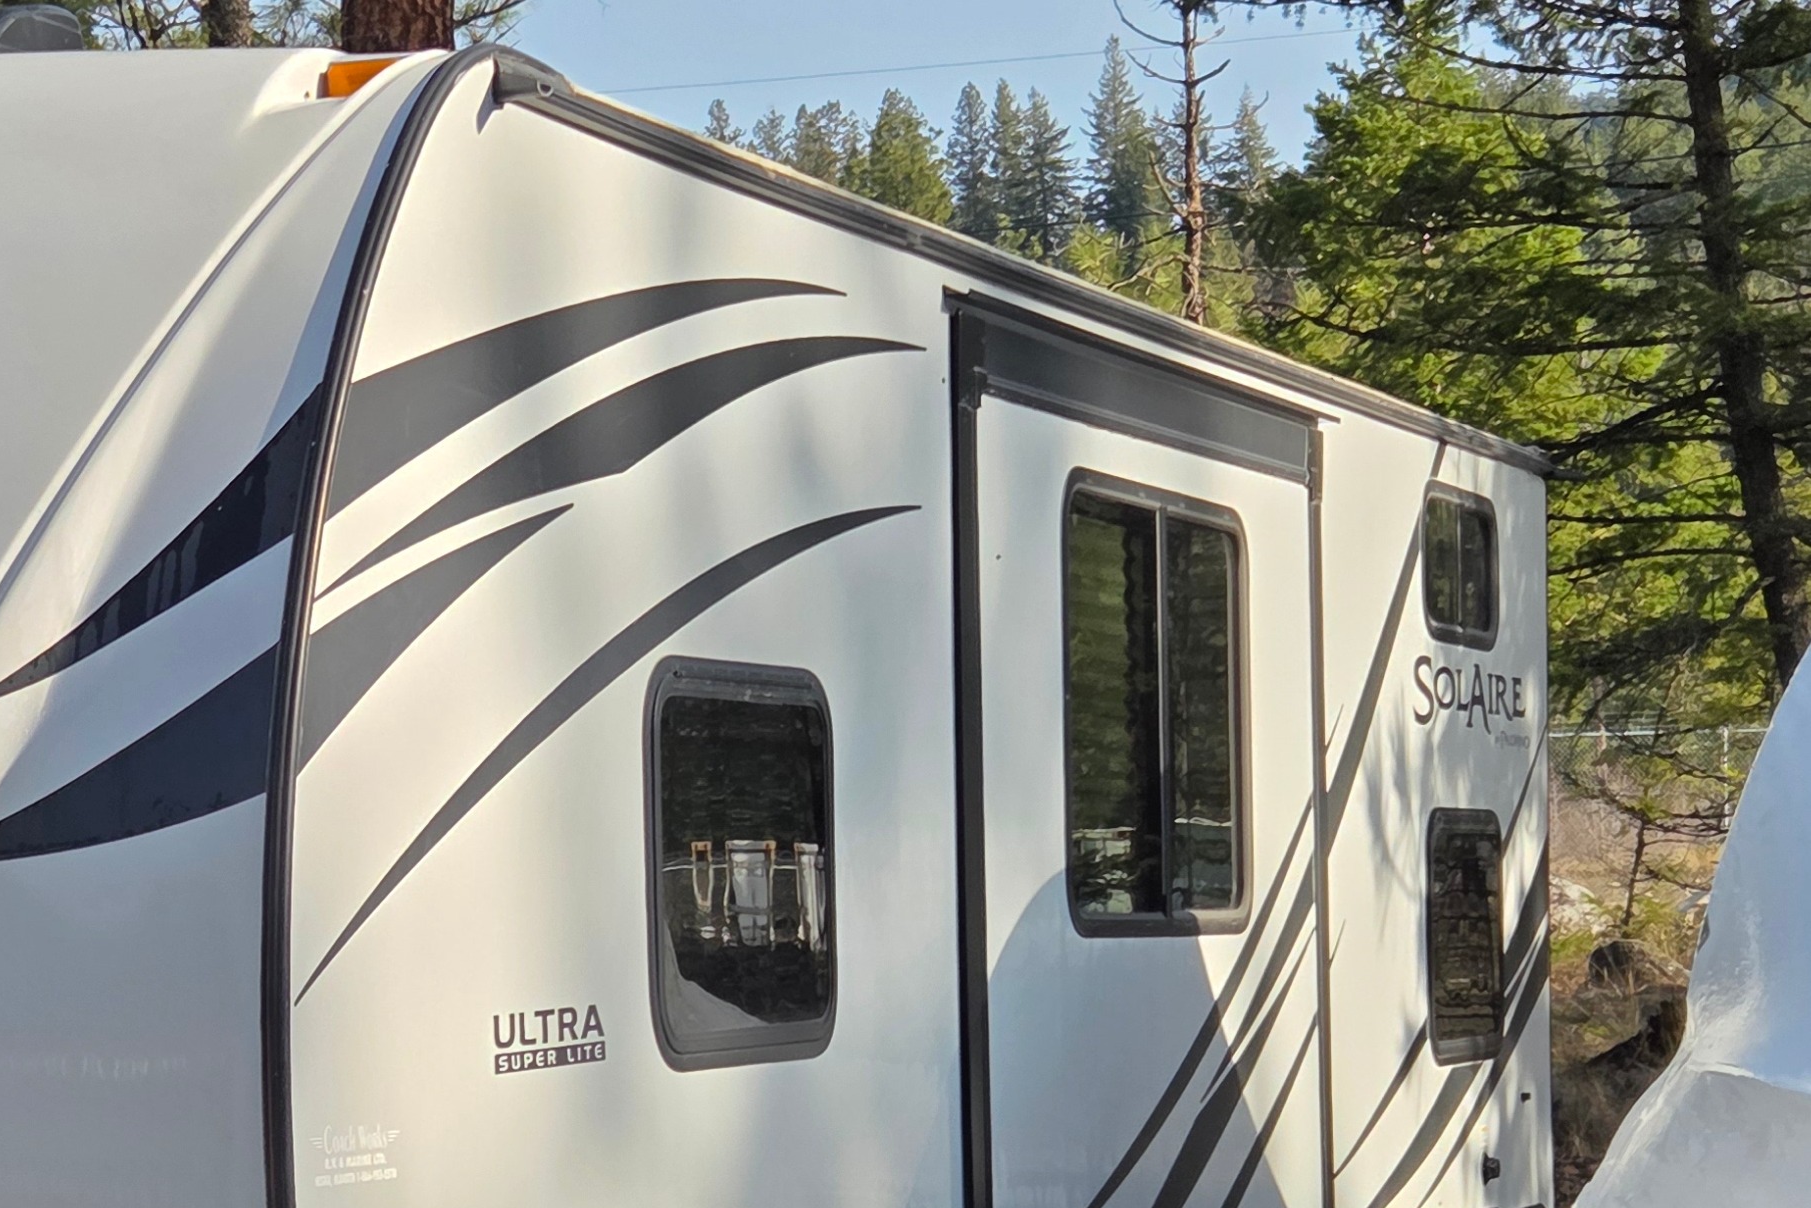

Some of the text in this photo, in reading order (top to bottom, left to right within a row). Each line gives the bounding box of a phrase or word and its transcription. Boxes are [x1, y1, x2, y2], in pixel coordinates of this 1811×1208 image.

[1412, 655, 1526, 735] SOLAIRE
[492, 1004, 606, 1049] ULTRA
[498, 1043, 604, 1072] SUPER LITE
